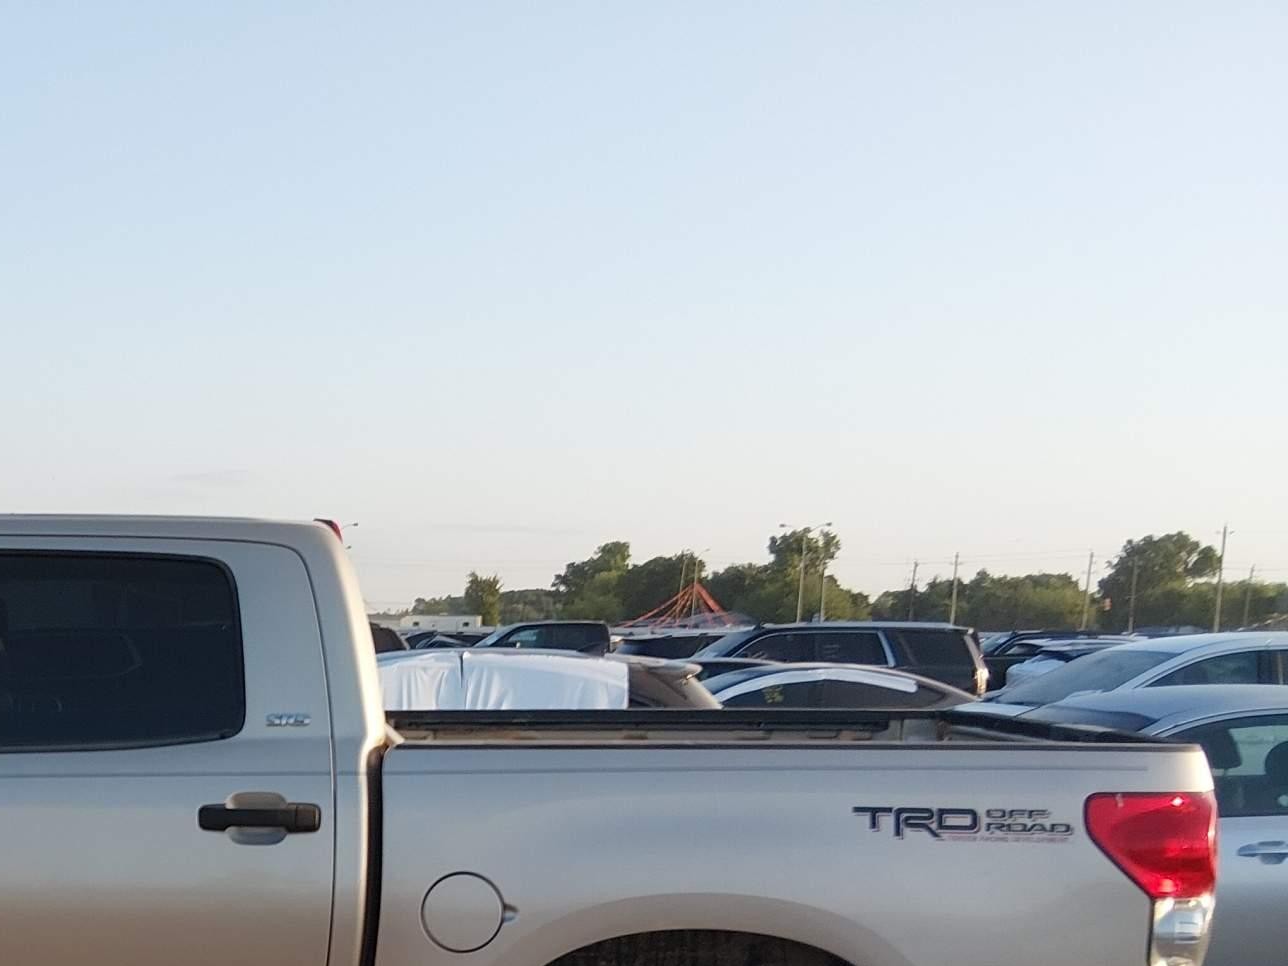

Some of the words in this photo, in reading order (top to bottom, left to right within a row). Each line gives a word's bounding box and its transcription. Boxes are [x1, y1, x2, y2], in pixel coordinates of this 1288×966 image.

[985, 808, 1052, 822] OFF
[852, 806, 979, 839] TRD
[985, 822, 1074, 836] ROAD
